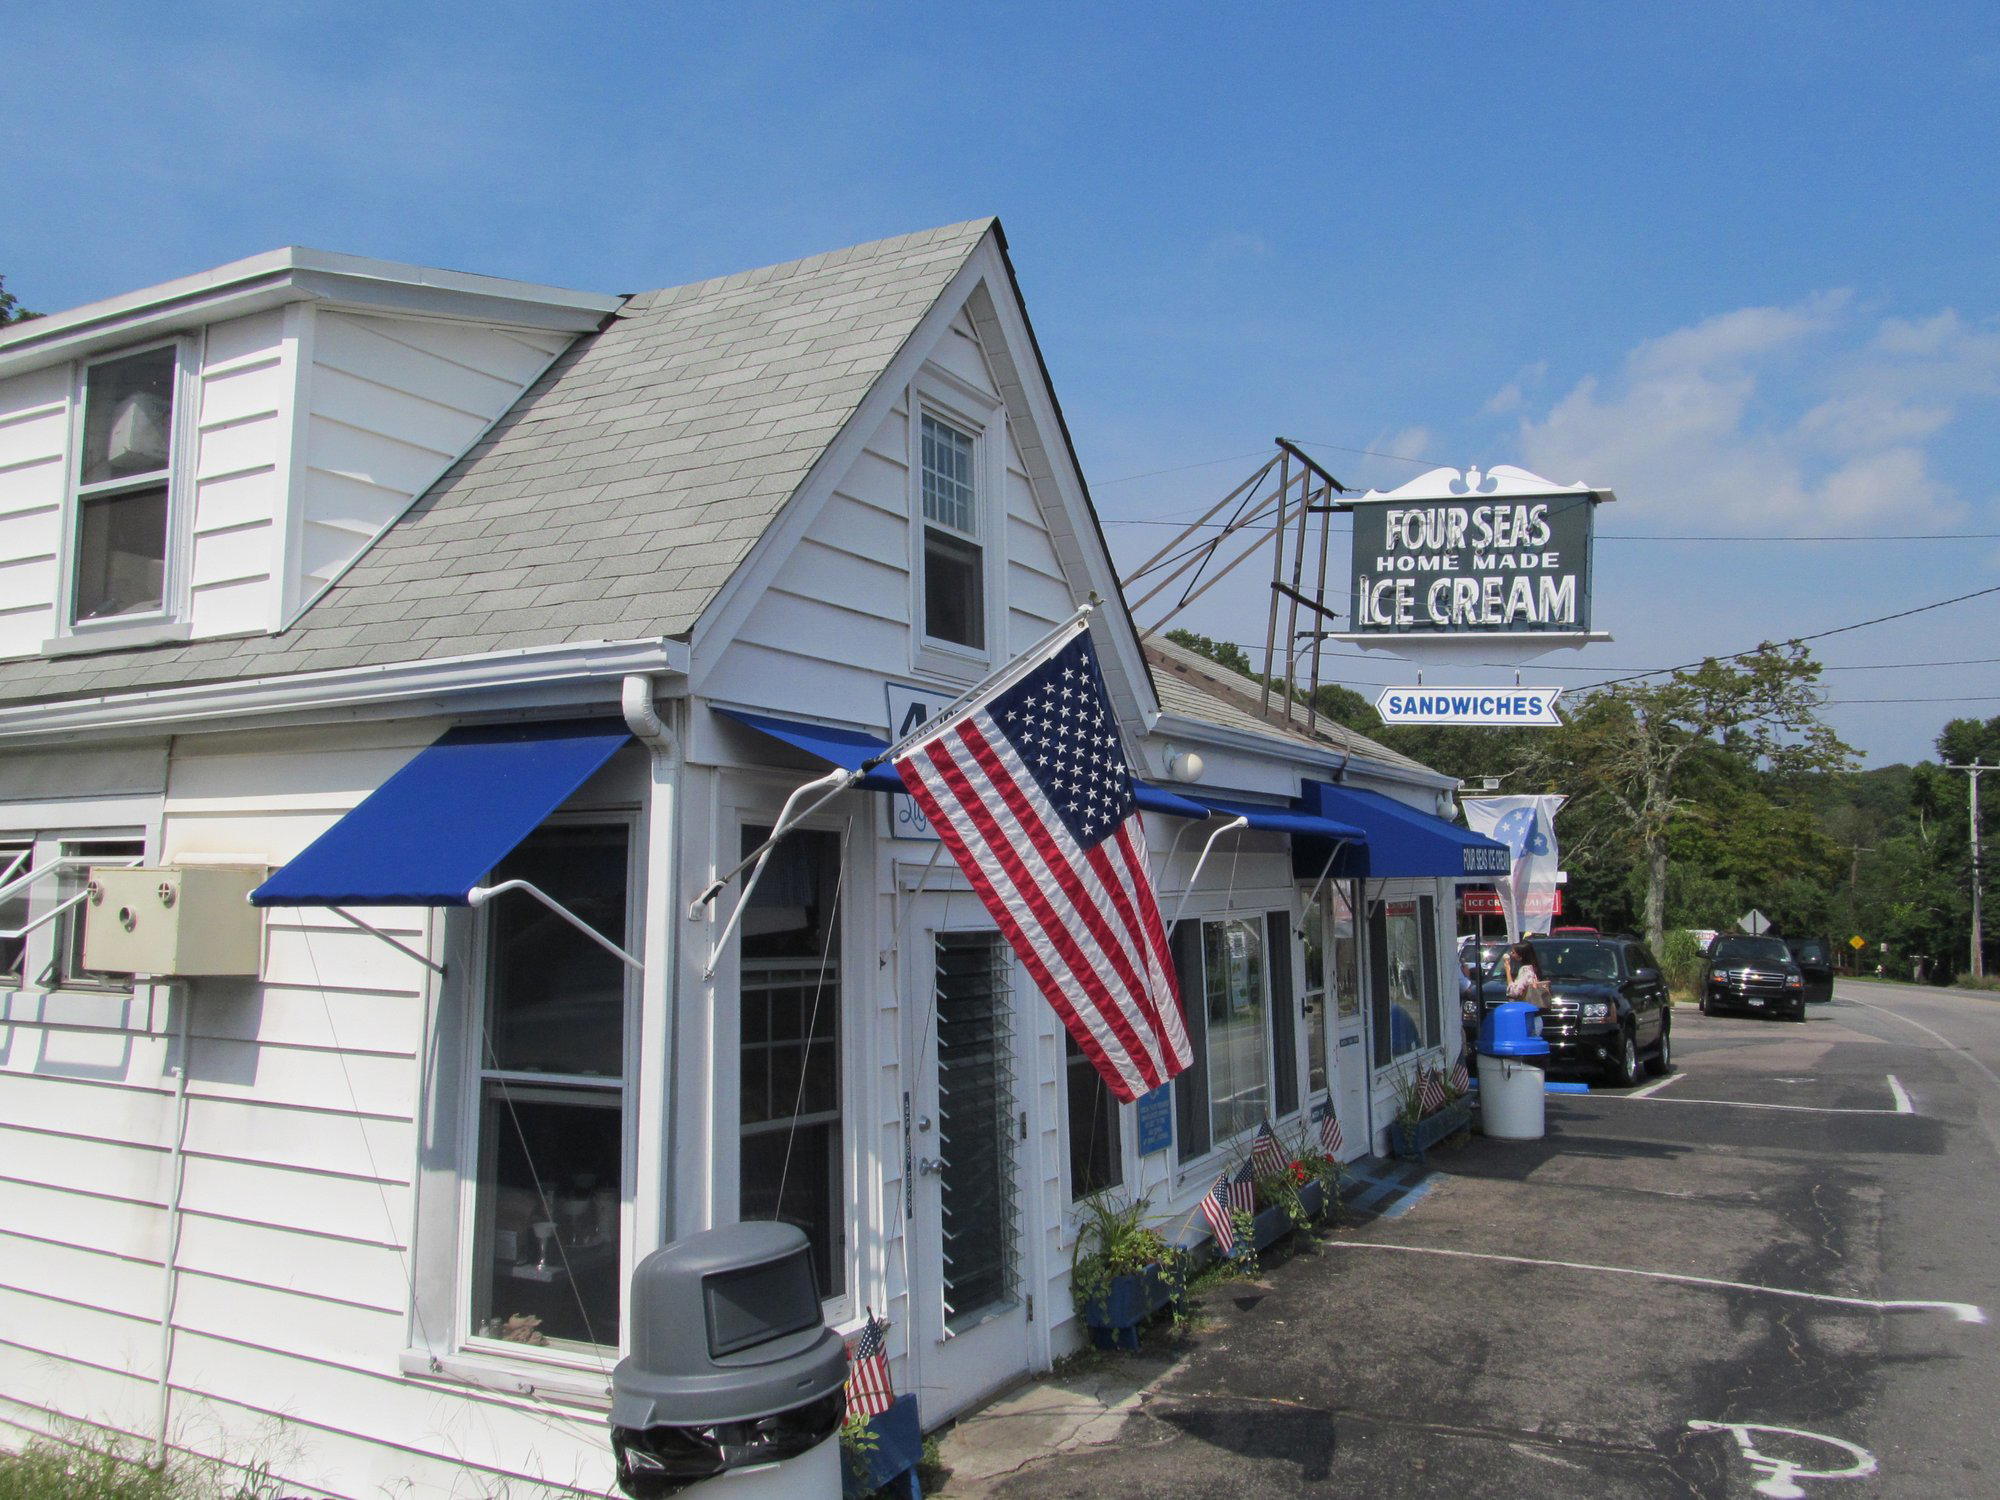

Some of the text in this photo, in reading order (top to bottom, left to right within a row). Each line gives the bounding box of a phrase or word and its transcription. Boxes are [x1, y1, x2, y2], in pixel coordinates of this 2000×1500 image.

[1386, 504, 1550, 550] FOUR SEAS
[1377, 552, 1559, 571] HOME MADE
[1359, 575, 1575, 625] ICE CREAM
[1389, 696, 1542, 716] SANDWICHES
[1463, 848, 1476, 870] FOUR
[1476, 848, 1488, 870] SEAS
